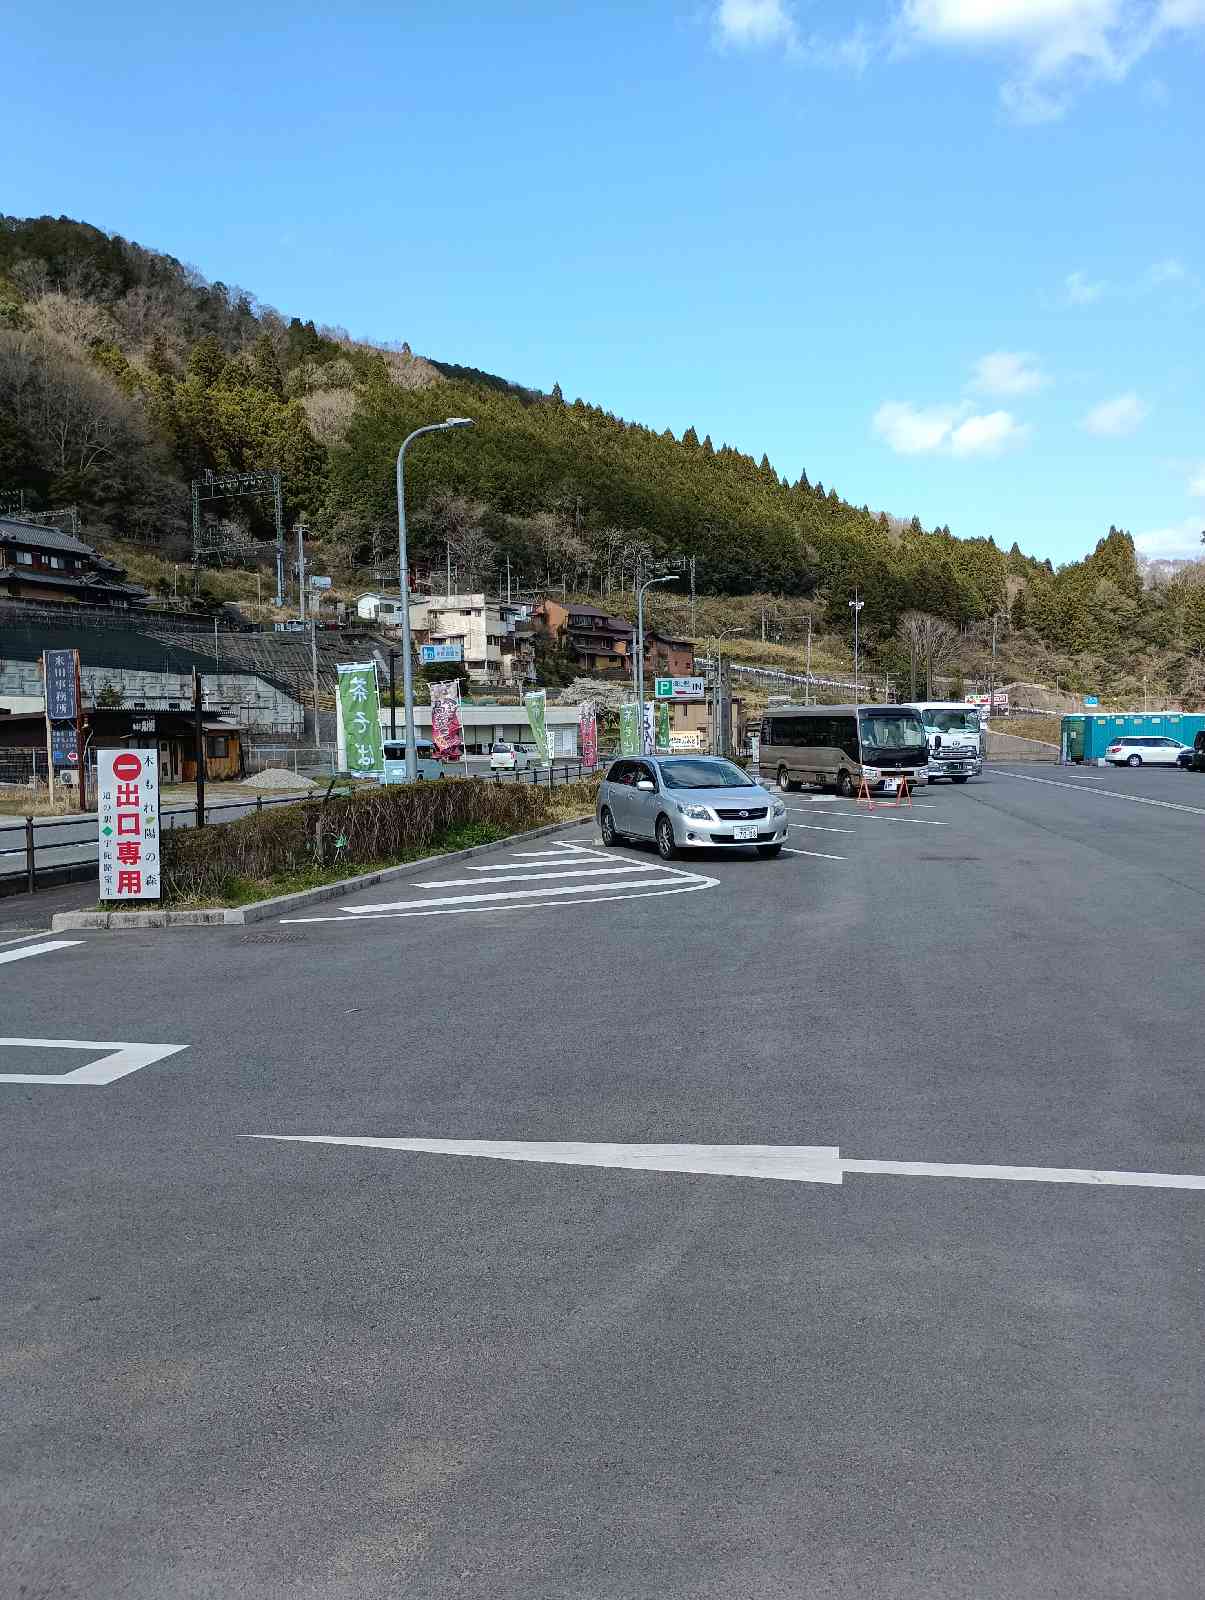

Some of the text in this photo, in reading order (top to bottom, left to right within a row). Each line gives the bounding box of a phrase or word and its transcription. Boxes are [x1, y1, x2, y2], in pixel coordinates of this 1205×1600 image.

[692, 683, 702, 691] IN
[116, 782, 142, 894] 出口専用
